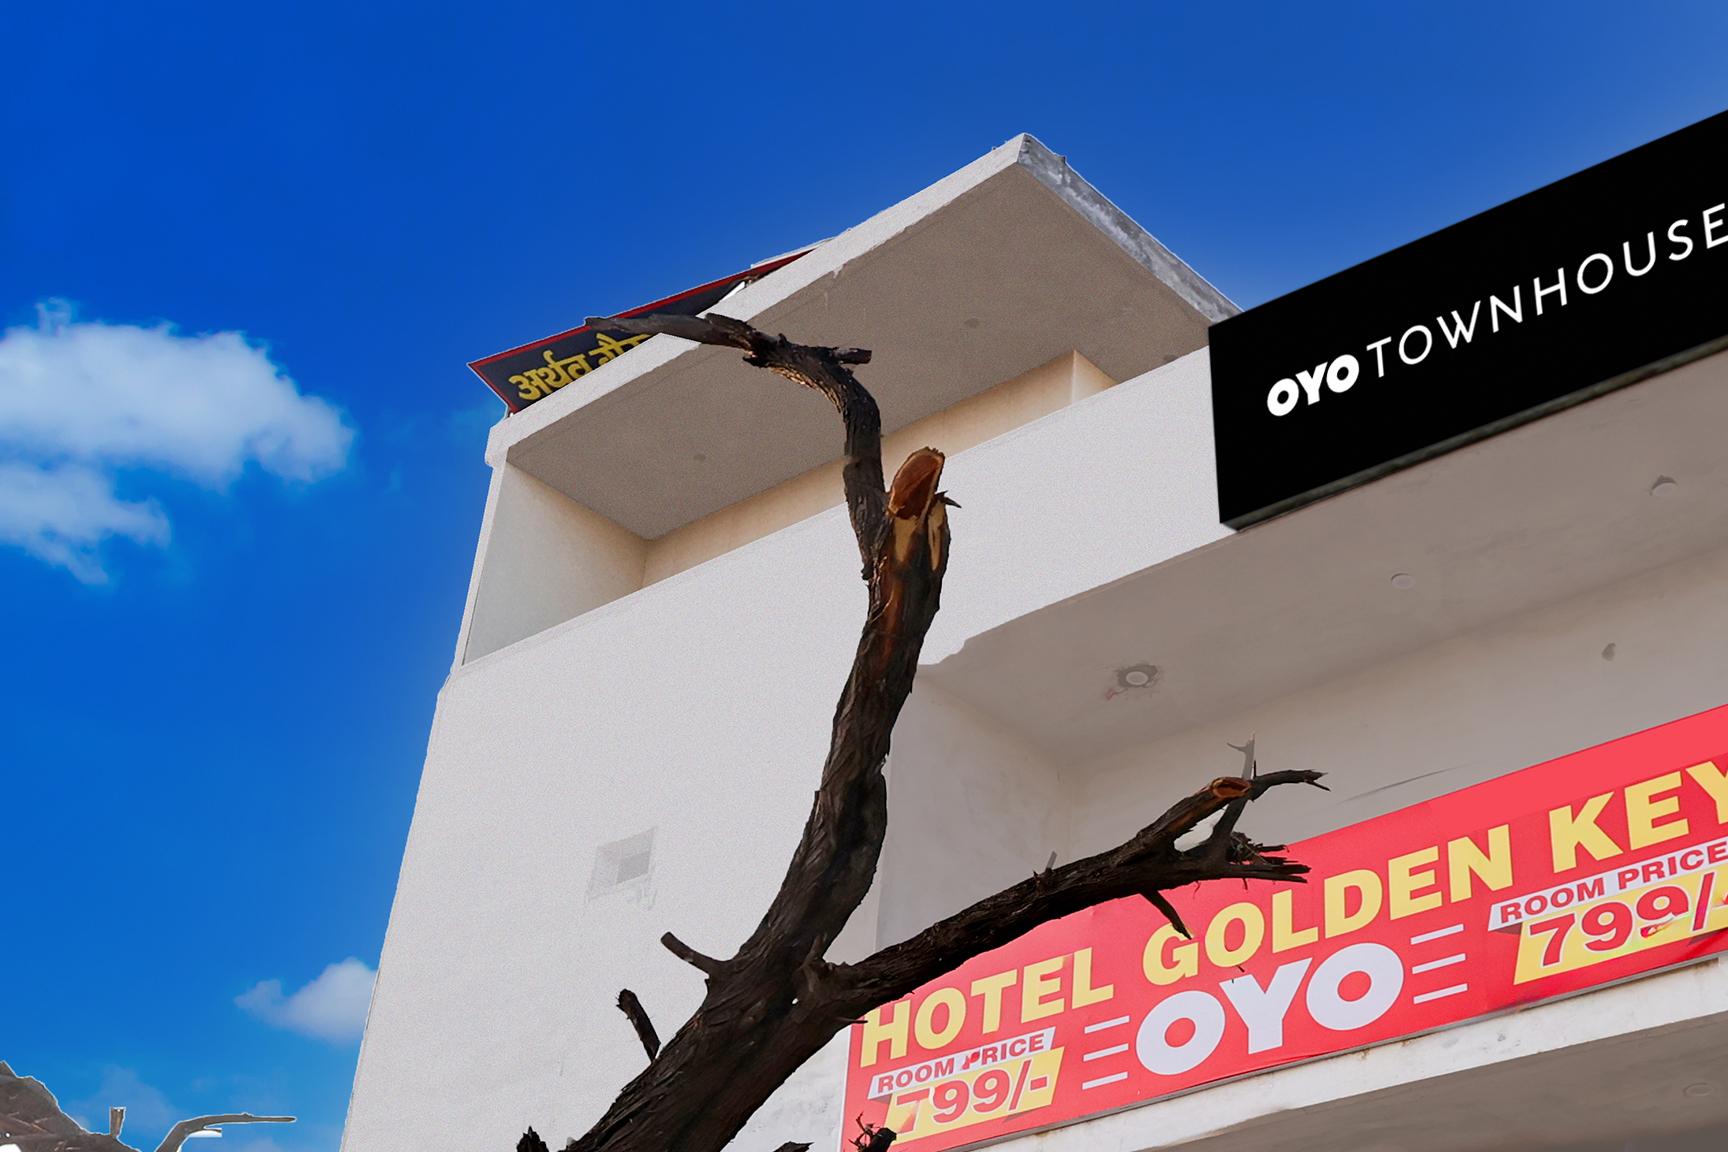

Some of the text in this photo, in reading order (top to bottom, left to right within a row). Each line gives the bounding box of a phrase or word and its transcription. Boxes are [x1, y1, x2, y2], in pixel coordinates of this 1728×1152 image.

[1266, 353, 1360, 417] OYO
[1500, 877, 1605, 925] ROOM
[860, 947, 1114, 1069] HOTEL
[1142, 824, 1513, 986] GOLDEN
[1135, 942, 1405, 1076] OYO
[877, 1057, 954, 1094] ROOM
